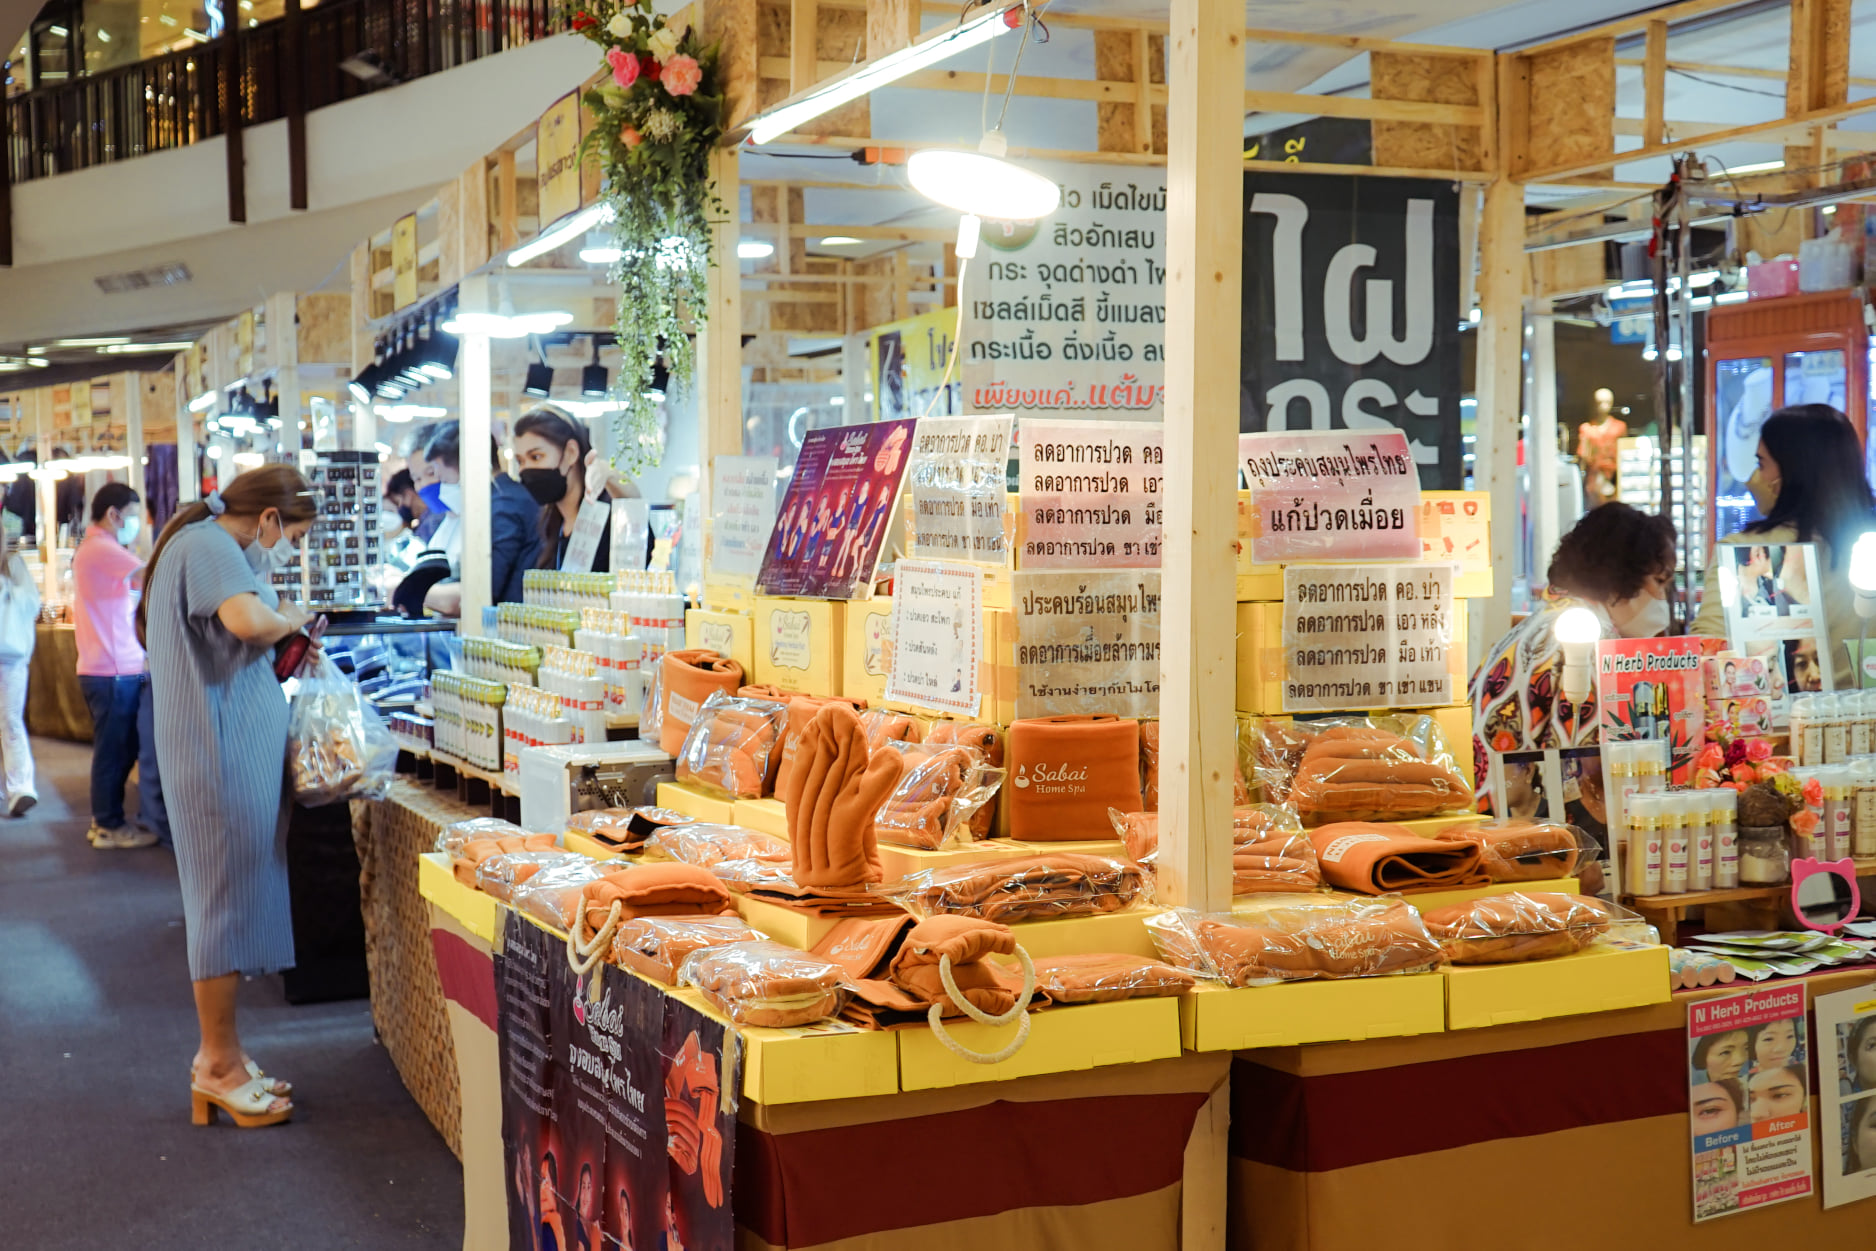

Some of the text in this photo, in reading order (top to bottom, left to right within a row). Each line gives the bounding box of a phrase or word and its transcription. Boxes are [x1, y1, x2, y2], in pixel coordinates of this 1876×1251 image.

[1054, 222, 1155, 249] สิวอักเสบ
[989, 262, 1028, 281] กระ
[1037, 258, 1137, 290] จุดด่างดำ
[1249, 192, 1435, 365] ไฝ
[973, 294, 1085, 322] เซลล์เม็ดสี
[971, 329, 1052, 360] กระเนื้อ
[1063, 329, 1133, 362] ติ่งเนื้อ
[1034, 440, 1132, 464] ลดอาการปวด
[1247, 444, 1408, 488] ถุงประคบสมุนไพรไทย
[1034, 472, 1129, 493] ลดอาการปวด
[1035, 505, 1131, 525] ลดอาการปวด
[1271, 488, 1404, 532] แก้ปวดเมื่อย
[1026, 538, 1115, 556] ลดอาการปวด
[1298, 576, 1387, 602] ลดอาการปวด
[1422, 572, 1441, 600] บ่า
[1022, 584, 1161, 623] ประคบร้อนสมุนไพ
[1296, 609, 1385, 633] ลดอาการปวด
[1397, 613, 1417, 631] เอว
[1296, 639, 1441, 666] ลดอาการปวด มือ เท้า
[1603, 650, 1698, 672] N Herb Products
[1288, 673, 1443, 698] ลดอาการปวด ขา เข่า แขน
[1032, 762, 1089, 783] Sabai
[1036, 784, 1086, 797] Home Spa
[1695, 1008, 1706, 1023] N
[1711, 1002, 1740, 1020] Herb
[1745, 993, 1799, 1014] Products
[1705, 1132, 1739, 1147] Before
[1769, 1120, 1796, 1133] After
